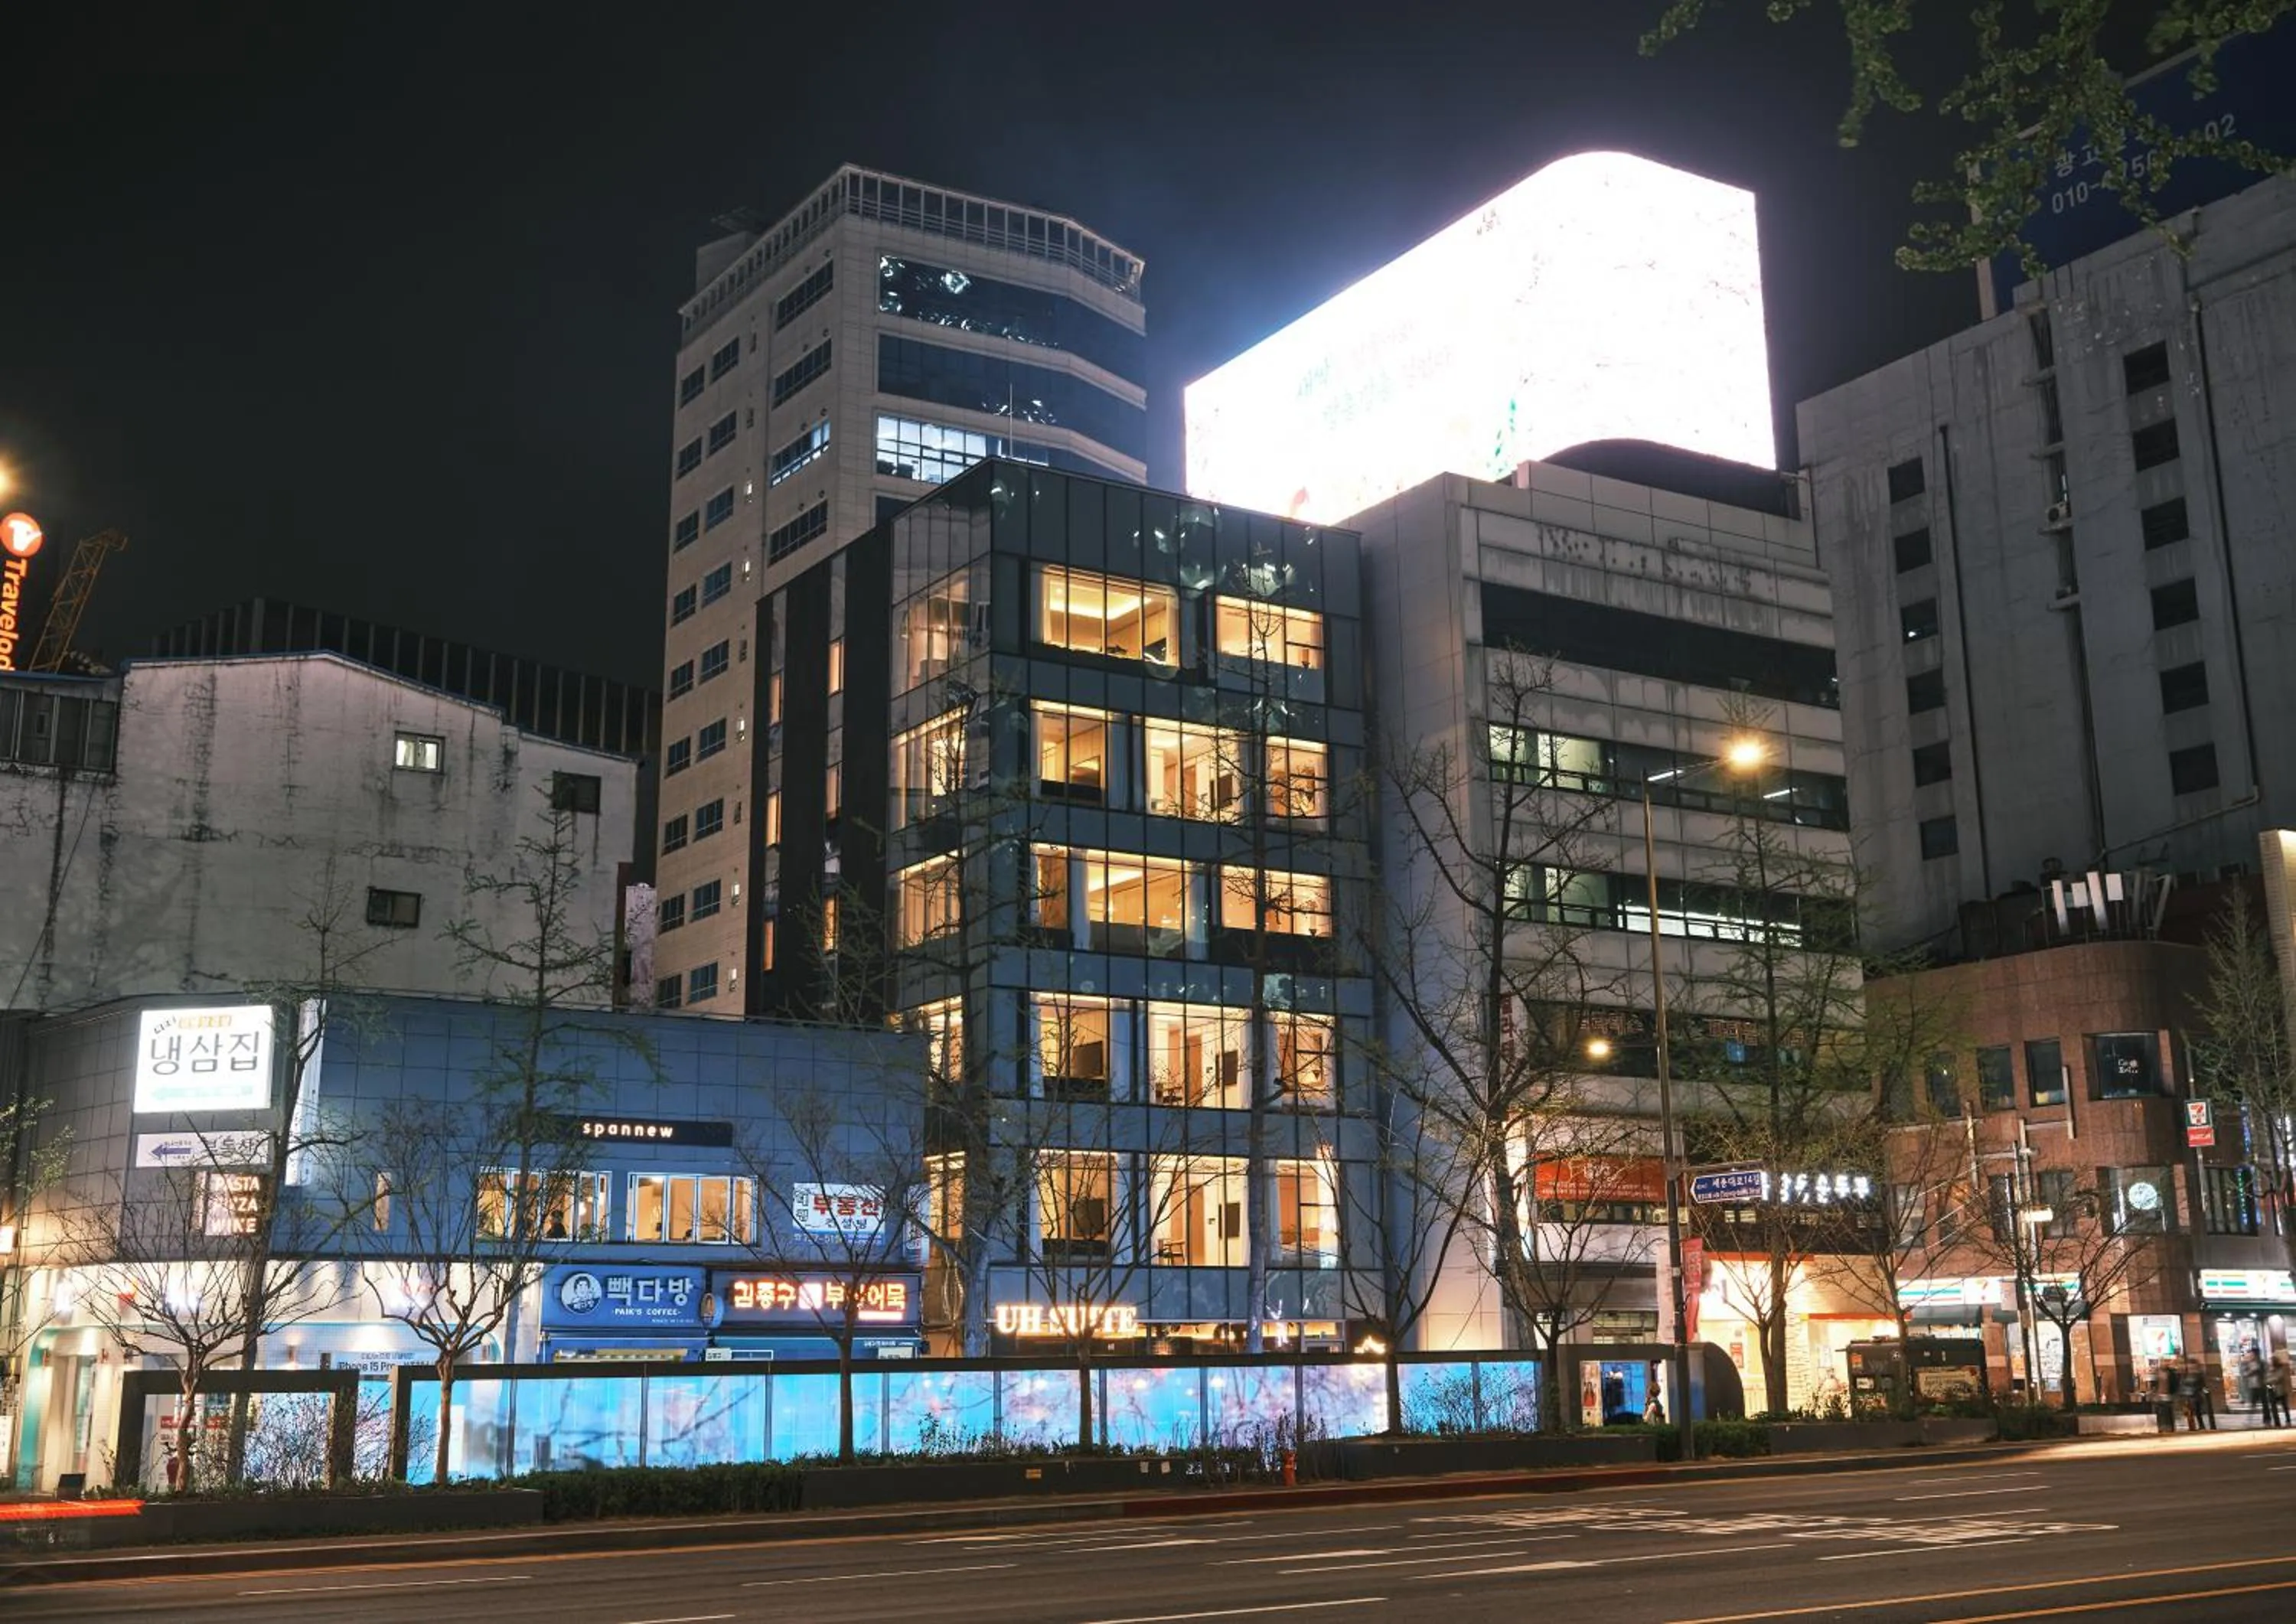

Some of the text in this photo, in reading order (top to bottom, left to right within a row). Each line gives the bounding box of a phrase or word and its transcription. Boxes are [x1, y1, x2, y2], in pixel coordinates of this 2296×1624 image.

[150, 1031, 260, 1075] 냉삼집
[582, 1123, 673, 1138] spannew
[813, 1195, 879, 1217] 부동산
[607, 1277, 694, 1306] 빽다방
[732, 1280, 797, 1310] 김종구
[995, 1304, 1043, 1334] UH
